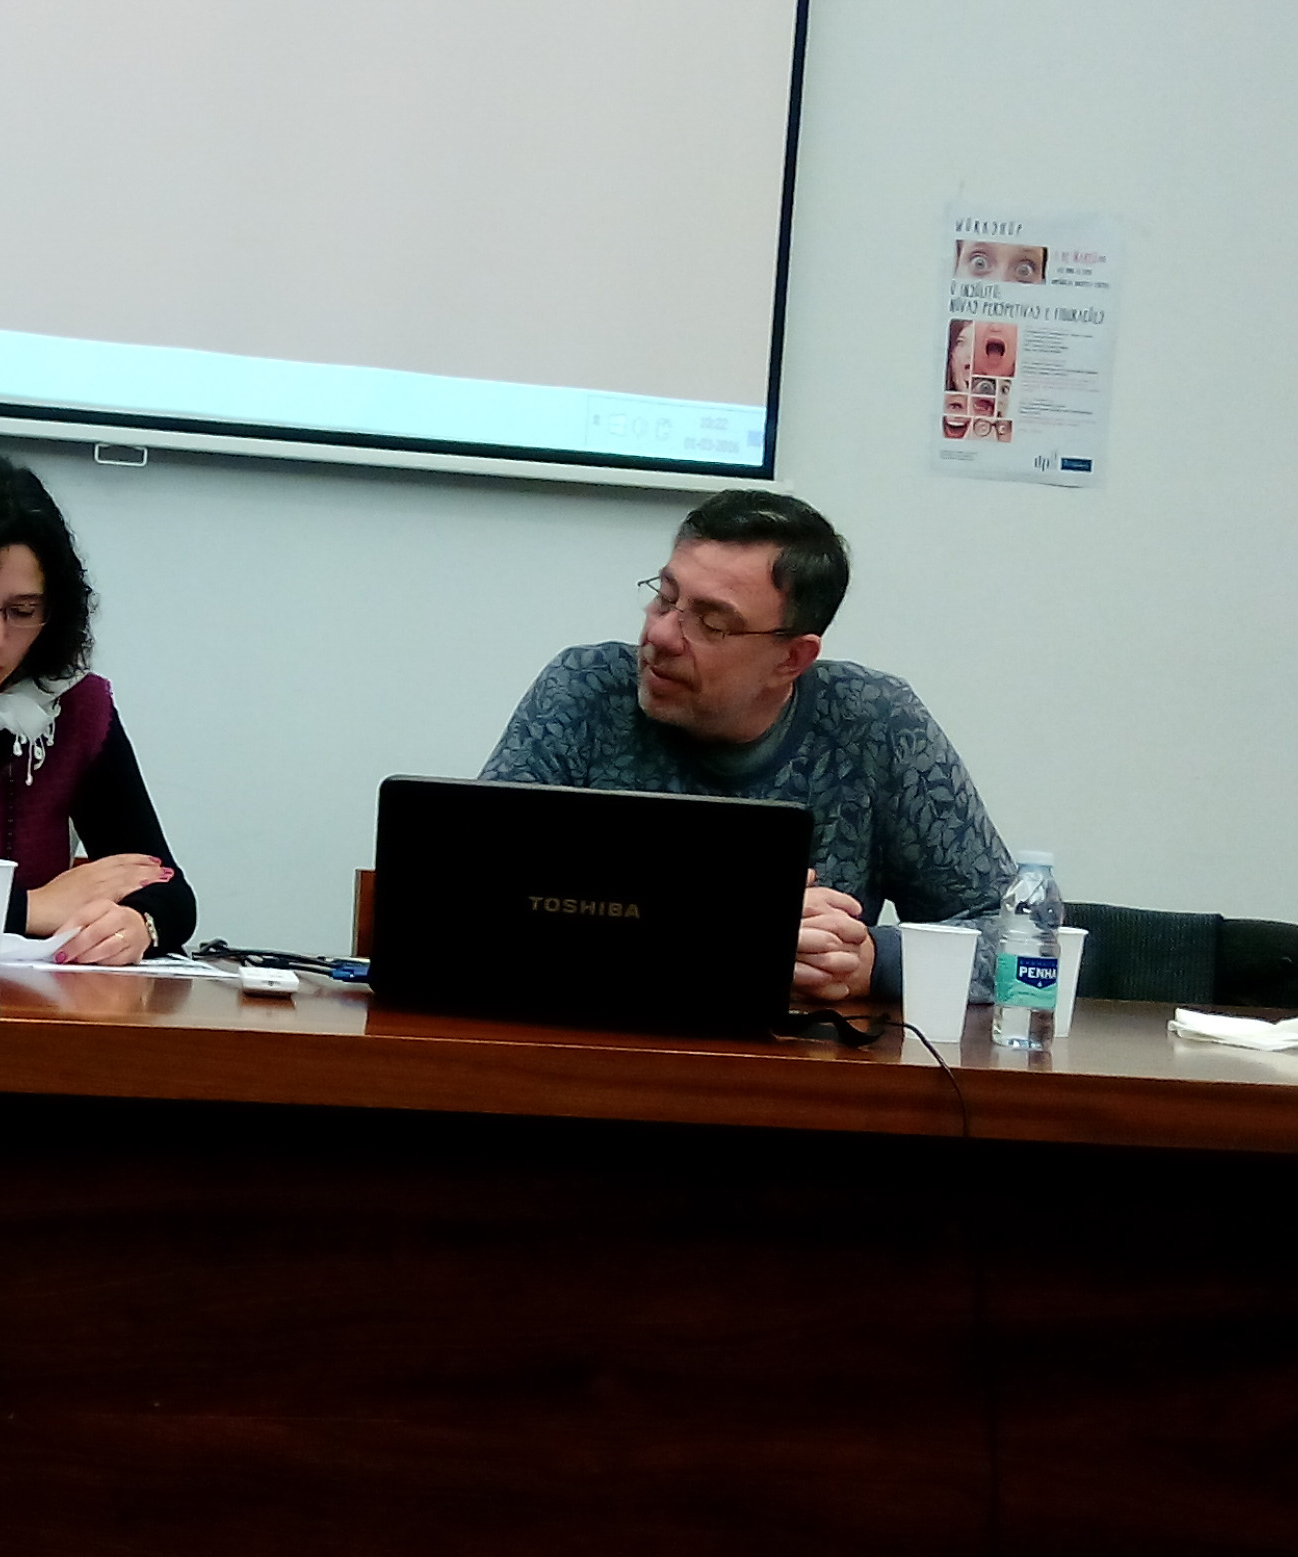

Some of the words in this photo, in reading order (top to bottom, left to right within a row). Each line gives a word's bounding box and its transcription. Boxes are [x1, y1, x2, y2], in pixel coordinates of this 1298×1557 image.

[955, 217, 1022, 236] WORKSHOP
[528, 896, 640, 919] TOSHIBA
[1018, 965, 1057, 980] PENHA
